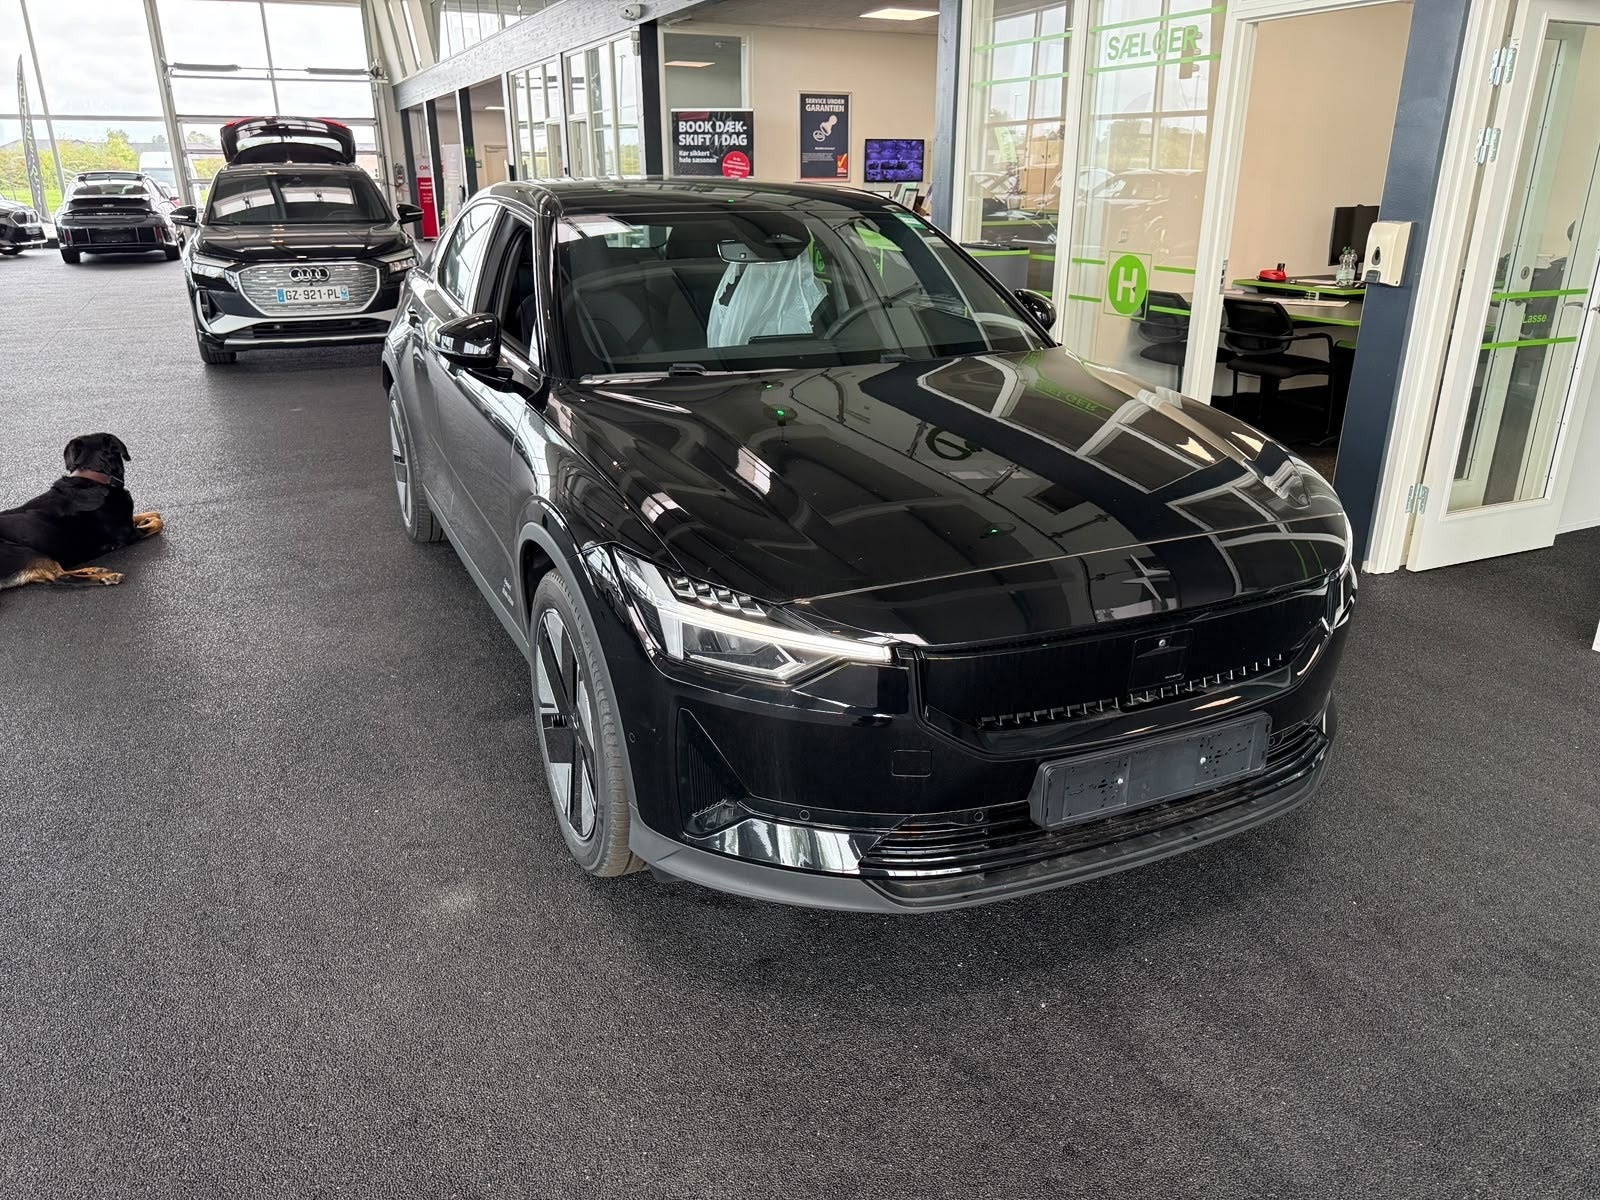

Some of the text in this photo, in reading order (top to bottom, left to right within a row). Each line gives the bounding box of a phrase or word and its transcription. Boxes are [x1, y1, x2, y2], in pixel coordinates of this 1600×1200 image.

[1107, 24, 1199, 61] SÆLGER
[805, 104, 845, 112] GARANTIEN
[678, 121, 748, 133] BOOK DÆK-
[678, 134, 748, 146] SKIFT I DAG
[1522, 313, 1548, 324] Lasse
